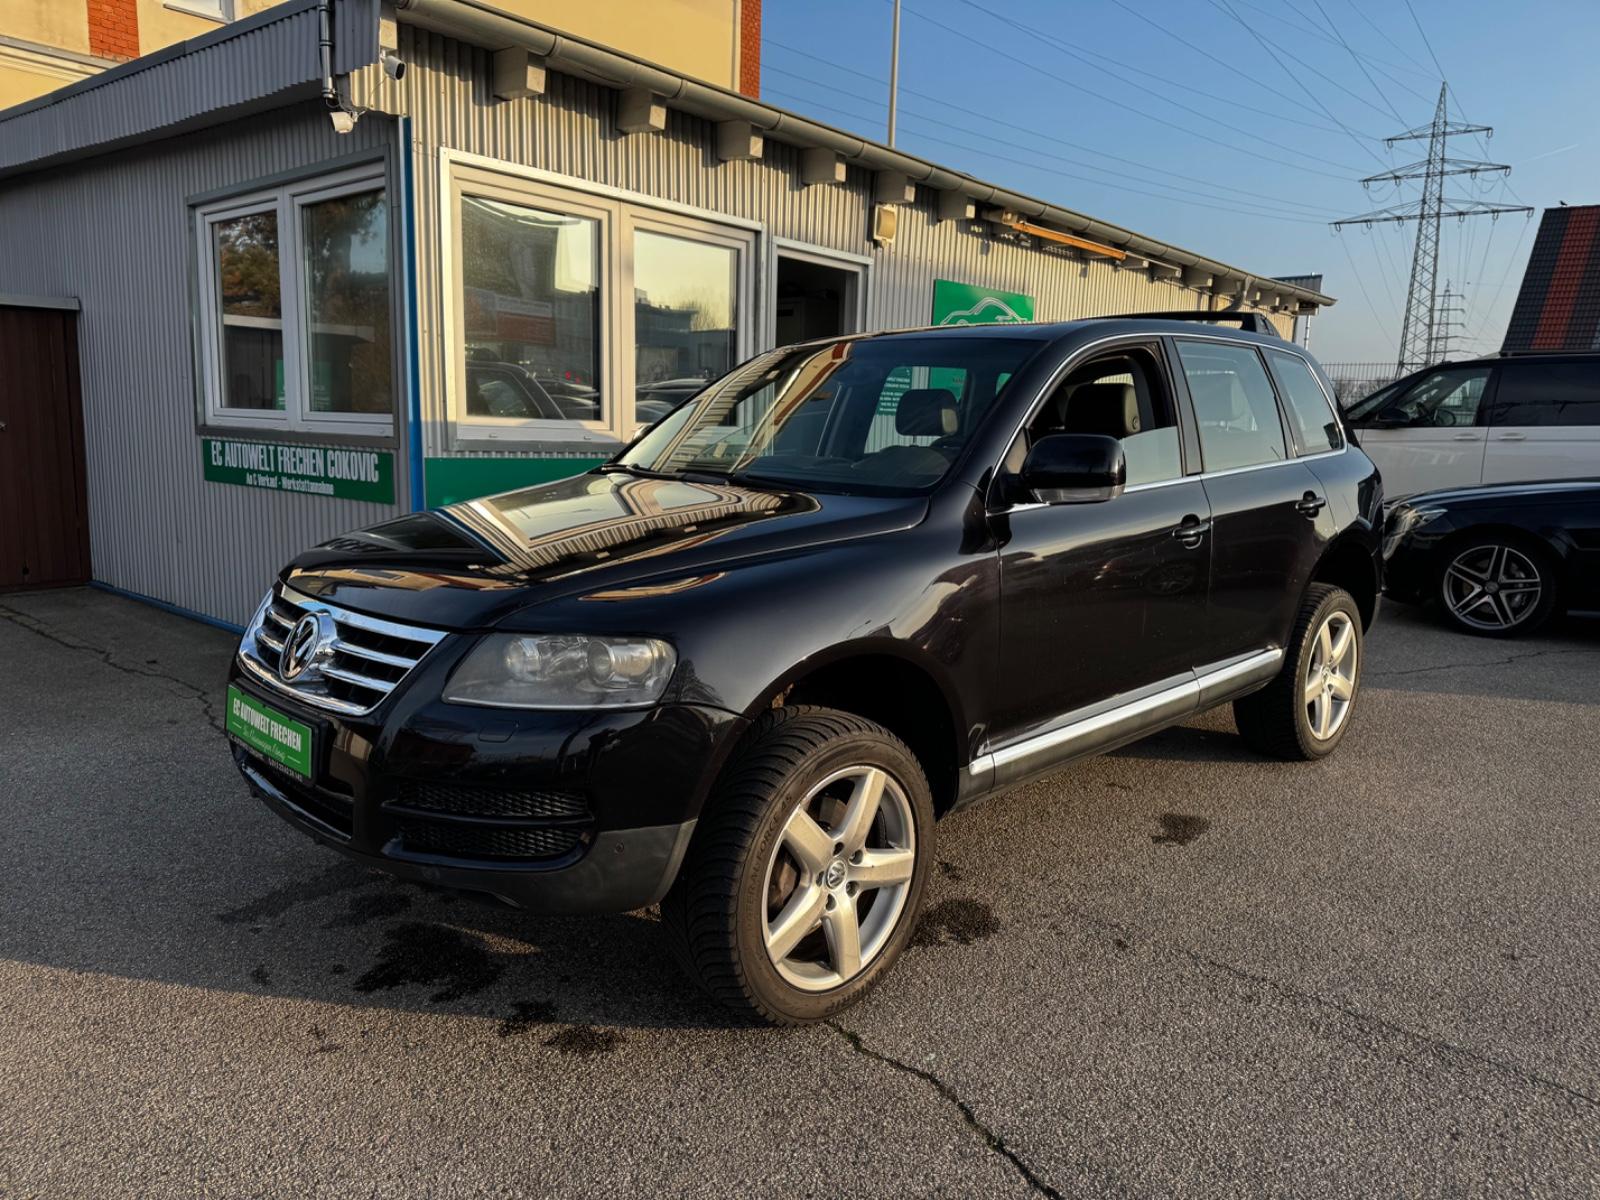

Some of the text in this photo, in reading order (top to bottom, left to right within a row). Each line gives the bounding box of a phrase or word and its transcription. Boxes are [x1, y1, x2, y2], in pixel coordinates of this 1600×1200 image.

[211, 441, 379, 483] EC AUTOWELT FRECHEN COKOVIC
[257, 474, 278, 489] Verkauf
[233, 697, 241, 716] EC
[240, 701, 270, 735] AUTOWELT
[270, 719, 302, 753] FRECHEN
